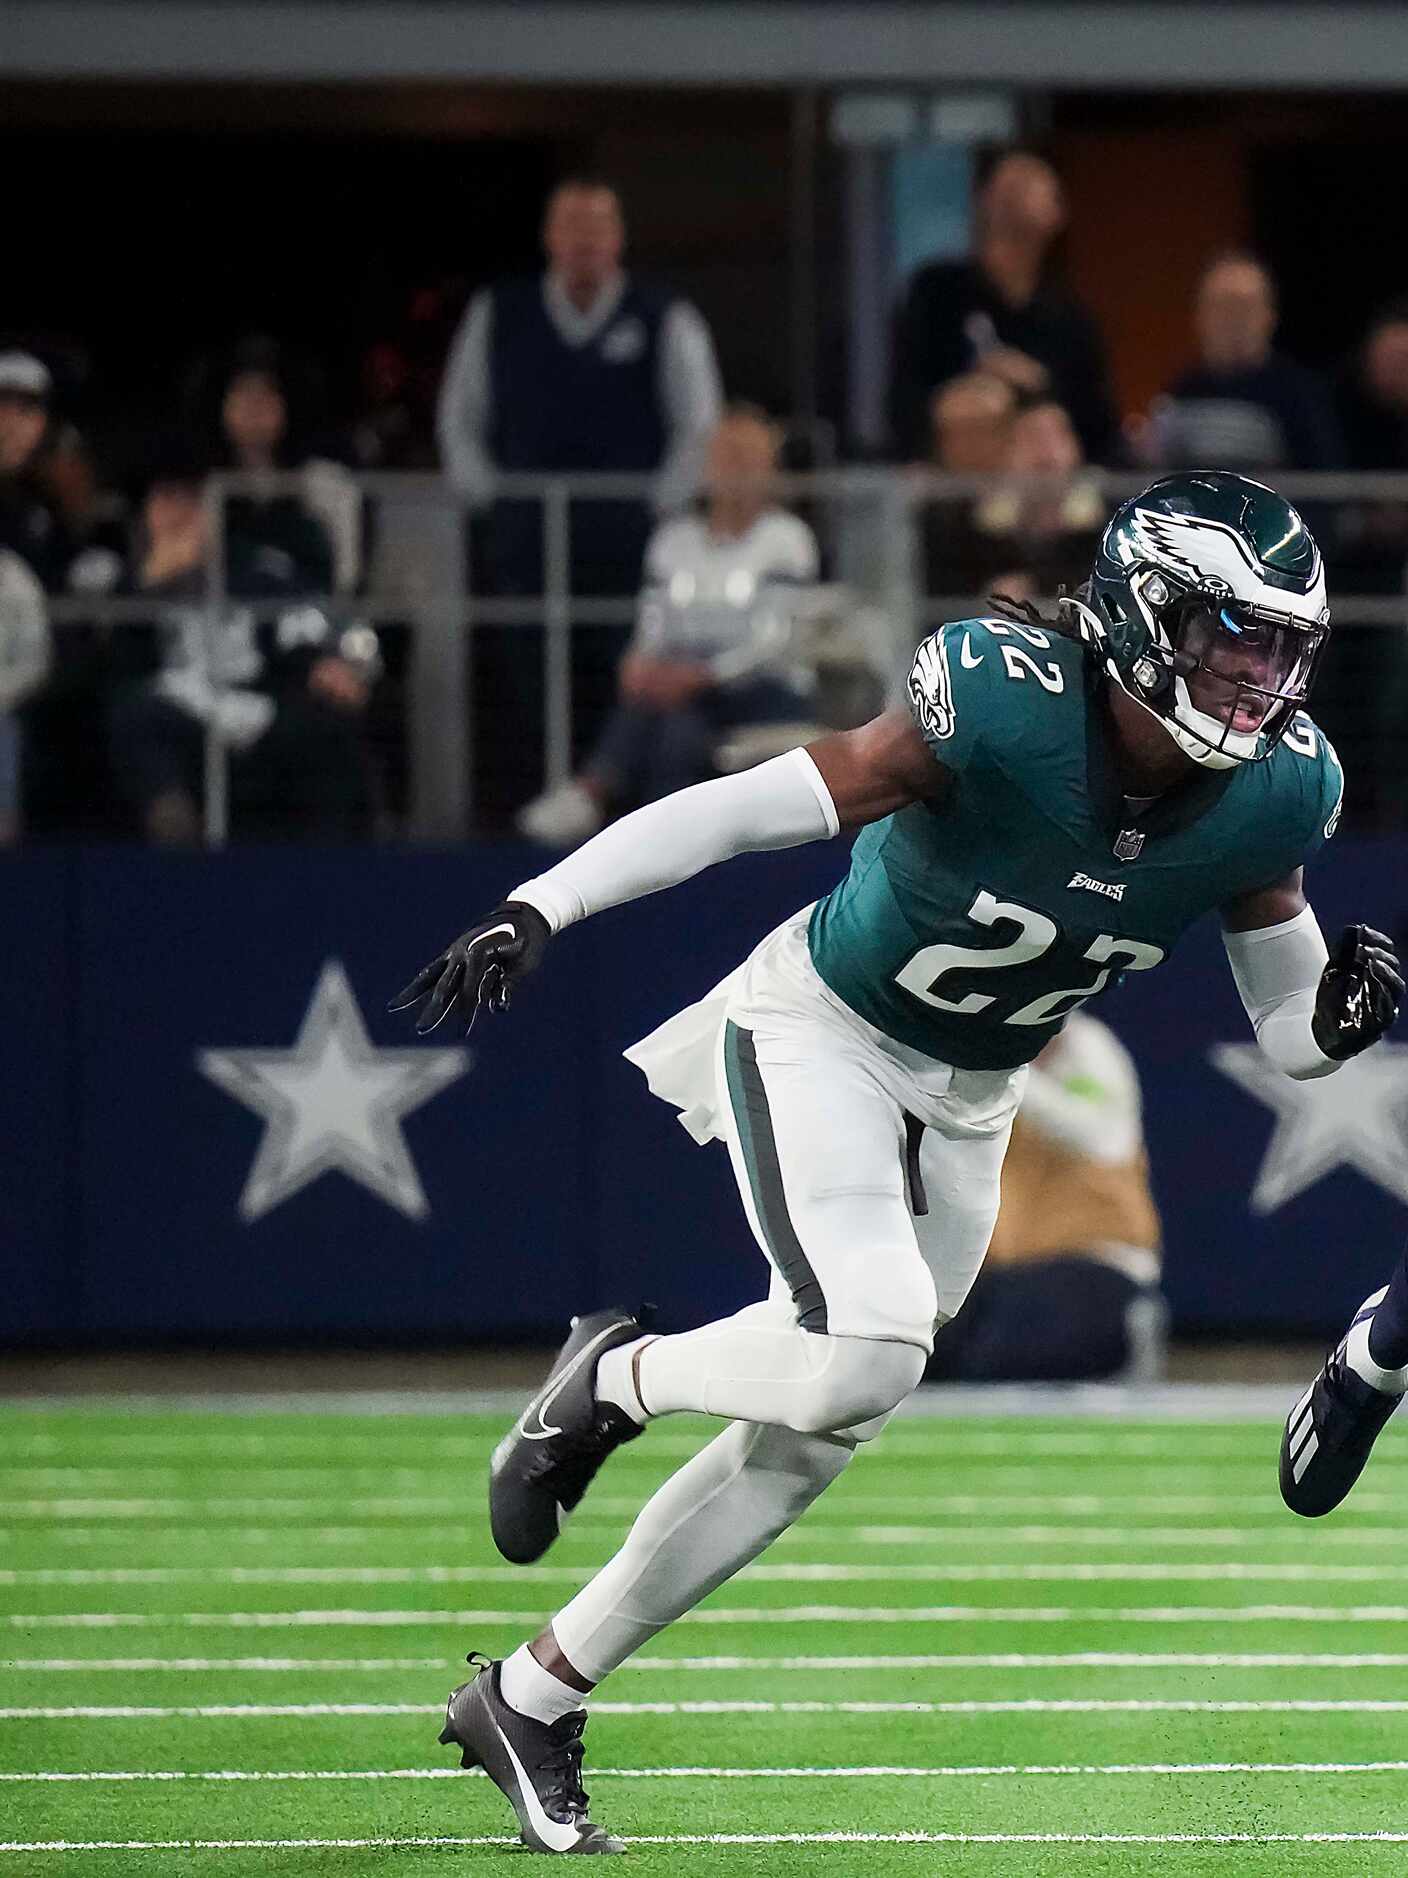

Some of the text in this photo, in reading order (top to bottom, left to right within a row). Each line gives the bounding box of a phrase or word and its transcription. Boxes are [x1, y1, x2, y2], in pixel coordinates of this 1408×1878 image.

[977, 618, 1064, 694] 22
[1066, 871, 1128, 902] EAGLES
[894, 889, 1166, 1027] 22
